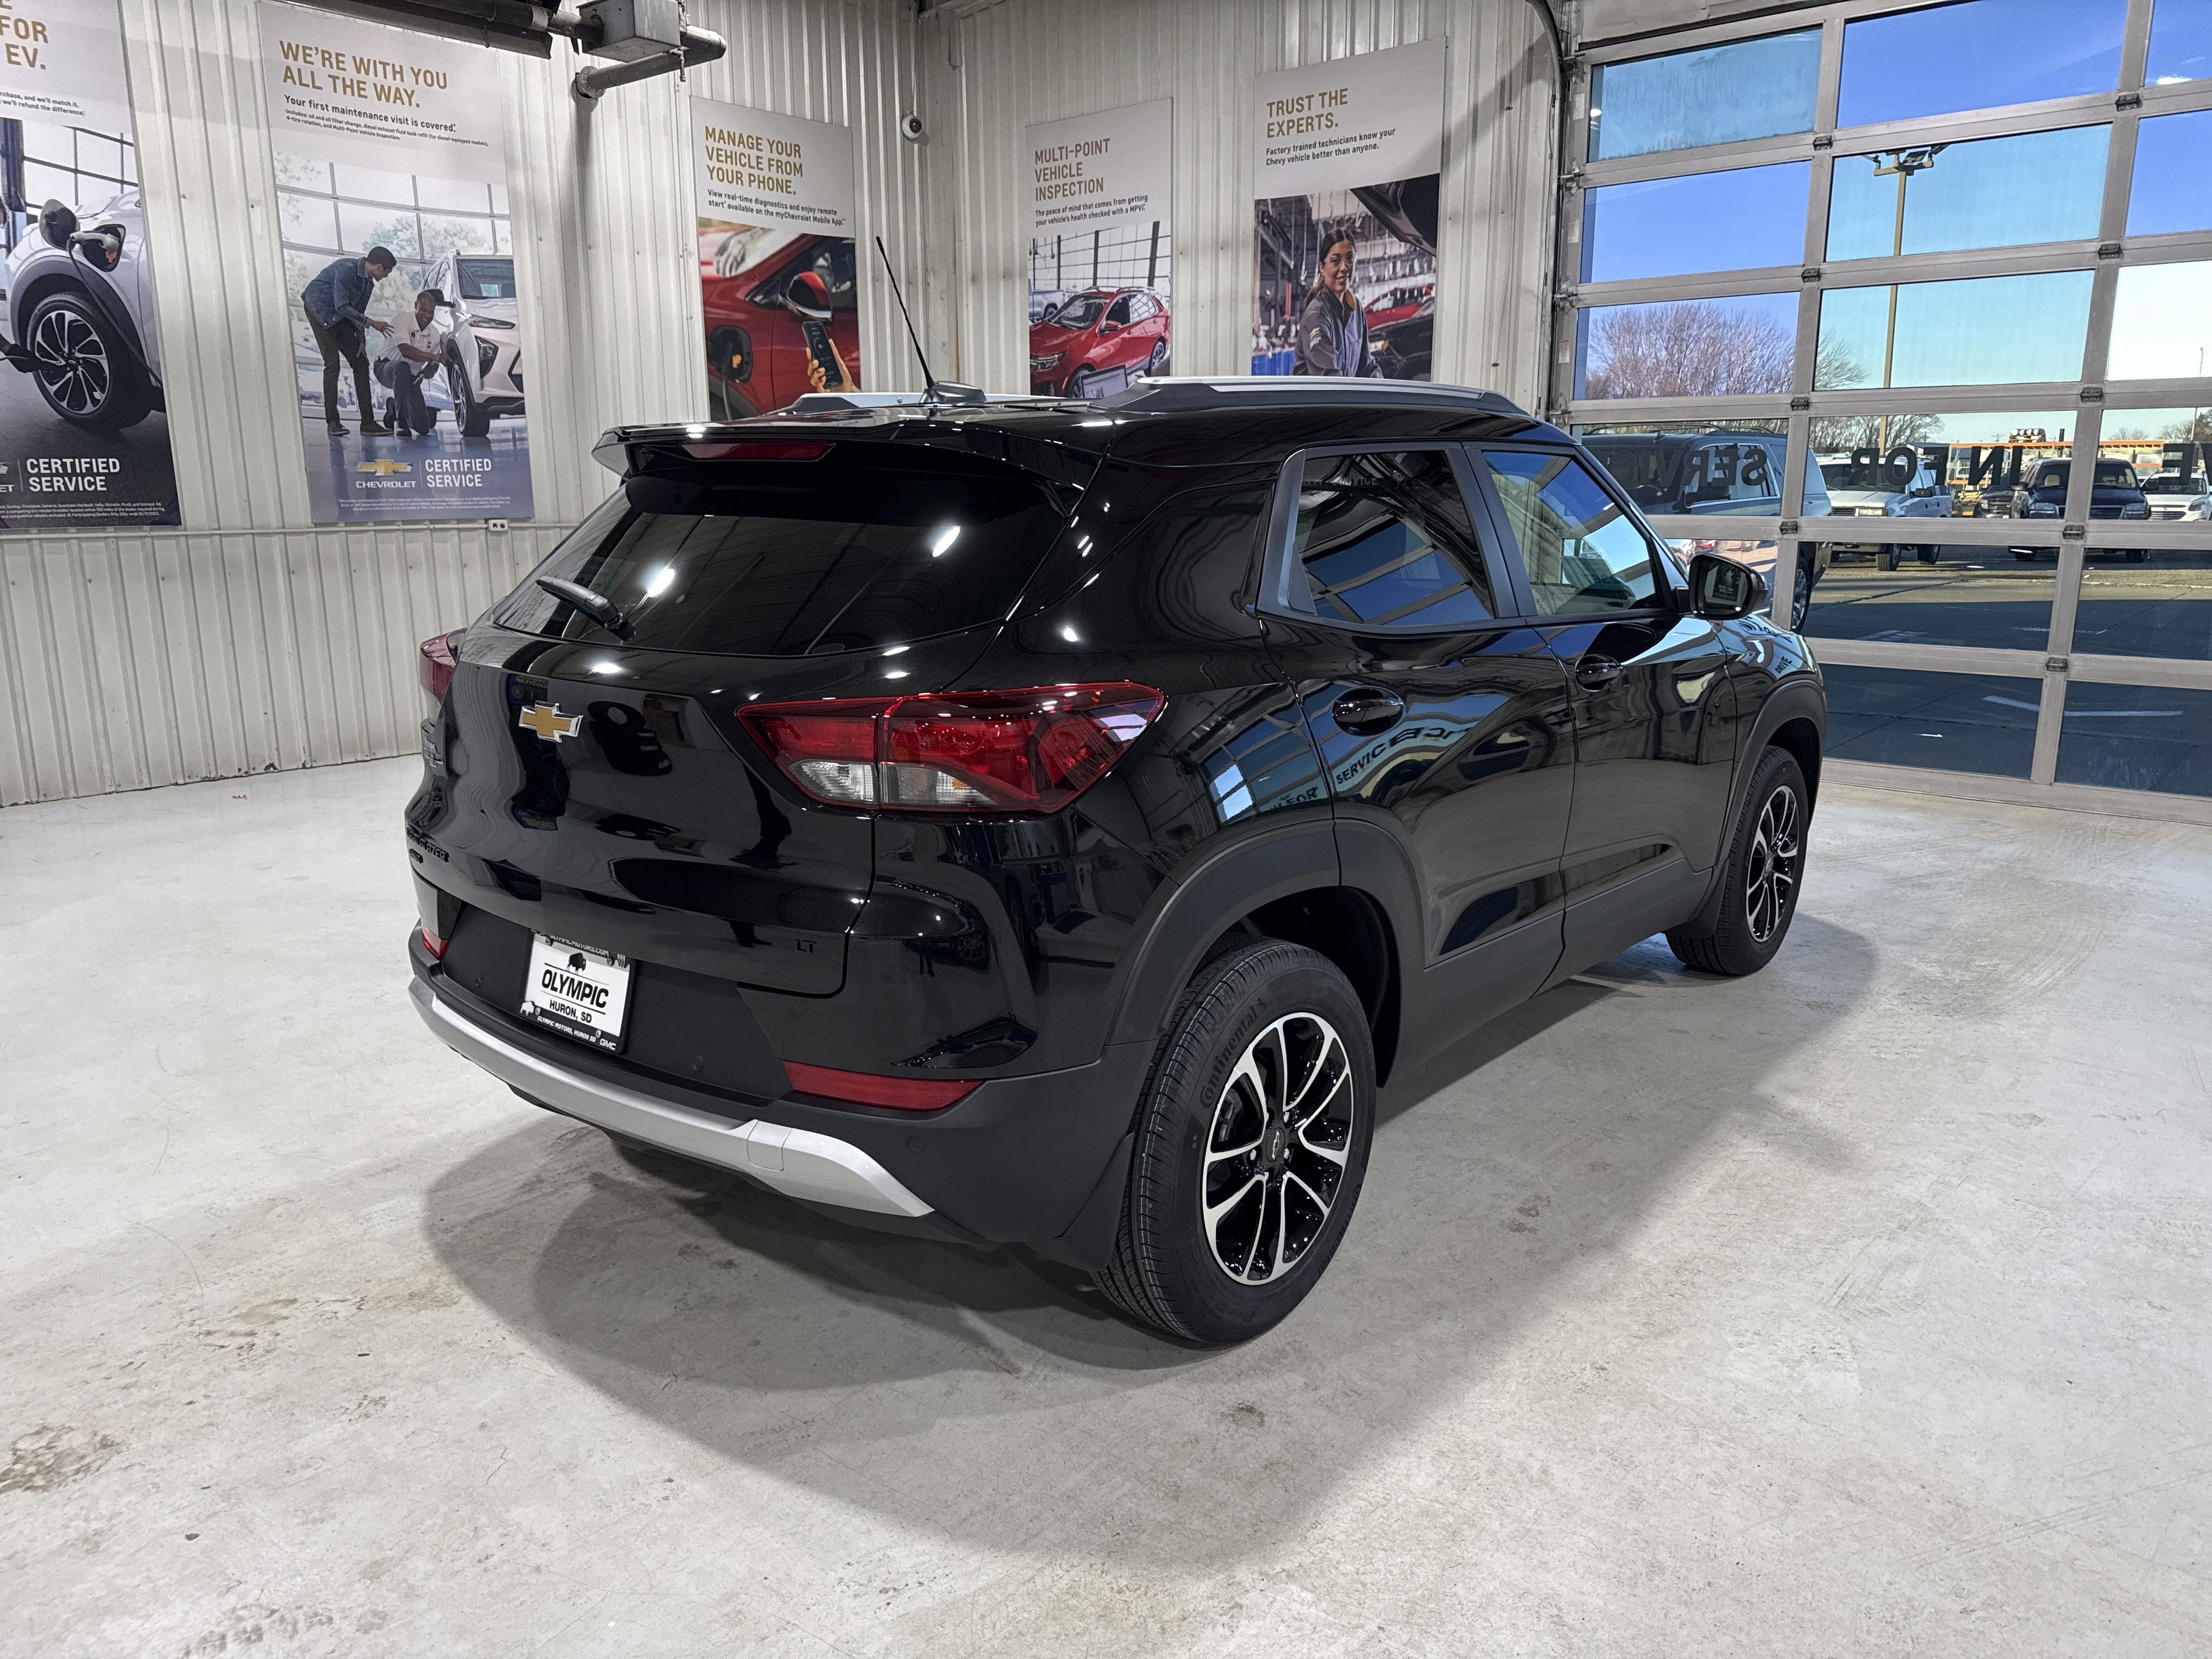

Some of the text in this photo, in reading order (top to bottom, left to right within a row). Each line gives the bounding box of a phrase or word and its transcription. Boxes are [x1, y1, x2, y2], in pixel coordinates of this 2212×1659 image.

[0, 15, 49, 43] FOR
[5, 43, 46, 70] EV.
[352, 55, 404, 83] WITH
[410, 66, 447, 89] YOU
[283, 65, 420, 108] ALL THE WAY.
[284, 94, 306, 106] Your
[308, 99, 330, 111] first
[332, 105, 388, 122] maintenance
[391, 115, 409, 126] visit
[411, 117, 418, 126] is
[1267, 88, 1348, 118] TRUST THE
[1267, 112, 1339, 138] EXPERTS.
[705, 126, 802, 159] MANAGE YOUR
[1035, 138, 1110, 165] MULTI-POINT
[1266, 128, 1396, 156] Factory trained technicians know your
[1266, 143, 1379, 166] Chevy vehicle better than anyone.
[705, 145, 803, 178] VEHICLE FROM
[1035, 162, 1083, 183] VEHICLE
[706, 164, 797, 195] YOUR PHONE.
[1035, 177, 1104, 202] INSPECTION
[708, 188, 837, 216] View real-time diagnostics and enjoy remote
[727, 202, 754, 215] available
[764, 208, 774, 217] the
[775, 211, 811, 223] myChevrolet
[812, 216, 830, 224] Mobile
[1046, 208, 1060, 217] peace
[1068, 204, 1081, 212] mind
[1094, 201, 1112, 209] comes
[1113, 198, 1126, 207] from
[1127, 195, 1148, 206] getting
[1035, 219, 1047, 228] your
[1071, 213, 1087, 221] health
[1088, 209, 1110, 218] checked
[1111, 207, 1124, 216] with
[26, 458, 120, 474] CERTIFIED
[425, 458, 492, 473] CERTIFIED
[29, 476, 107, 492] SERVICE
[426, 474, 483, 488] SERVICE
[794, 939, 817, 953] LT
[541, 969, 609, 1008] OLYMPIC
[549, 999, 592, 1023] HURON, SD
[537, 1015, 555, 1027] OLYMPIC
[555, 1022, 573, 1035] MOTORS,
[574, 1030, 589, 1040] HURON
[599, 1038, 617, 1051] GMC
[1199, 1005, 1259, 1110] Continental
